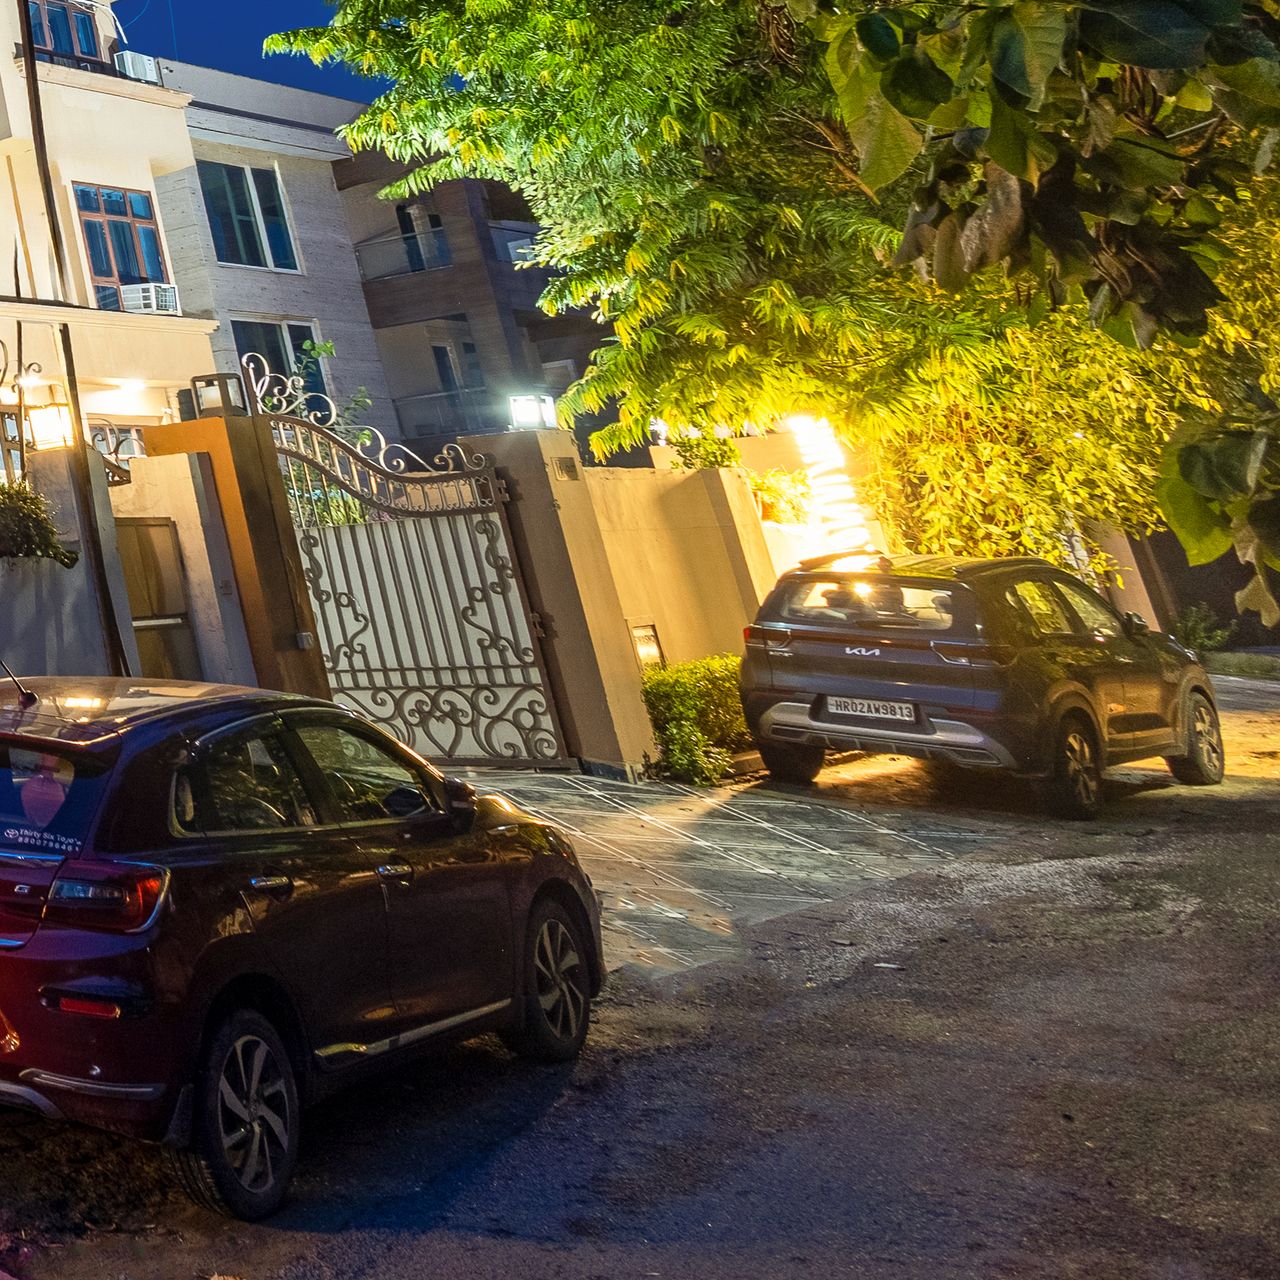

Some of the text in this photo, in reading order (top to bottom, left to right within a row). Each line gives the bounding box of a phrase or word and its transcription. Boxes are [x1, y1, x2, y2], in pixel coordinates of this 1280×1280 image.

[845, 647, 880, 656] KIA
[834, 700, 913, 718] HR02AW9813
[42, 832, 55, 840] Six
